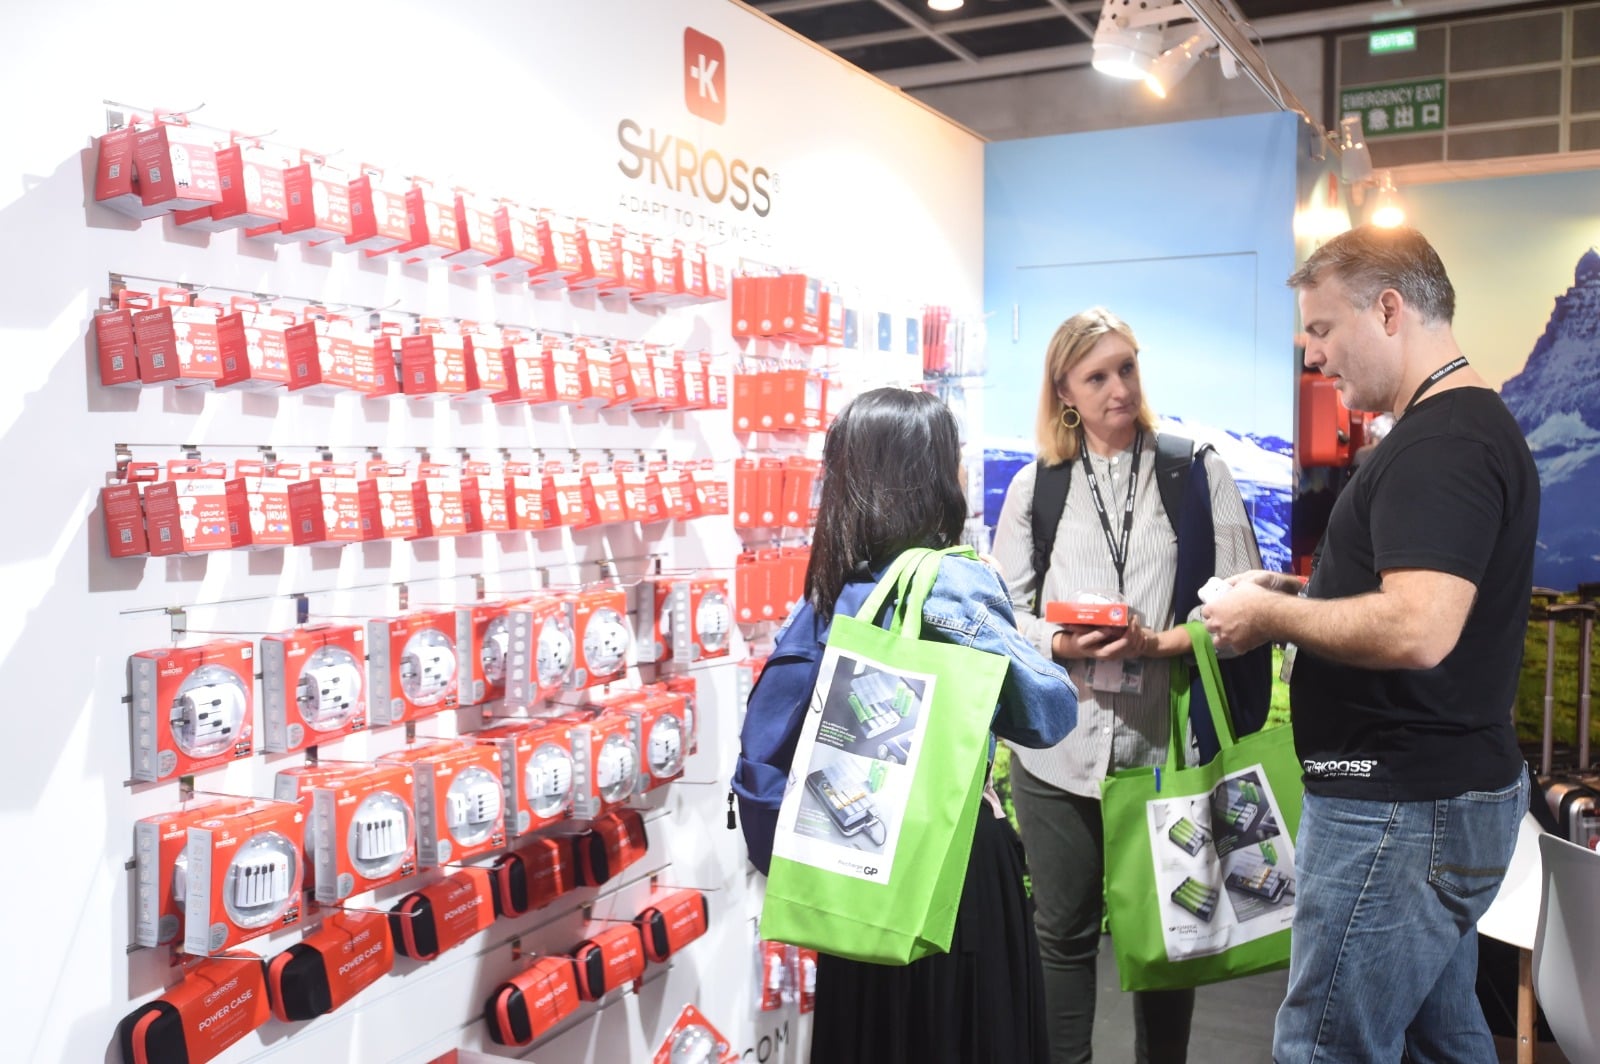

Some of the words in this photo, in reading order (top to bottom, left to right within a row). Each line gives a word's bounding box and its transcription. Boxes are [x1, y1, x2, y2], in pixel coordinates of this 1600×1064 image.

[1342, 88, 1413, 110] EMERGENCY
[1415, 83, 1442, 102] EXIT
[617, 118, 771, 218] SKROSS
[618, 194, 669, 221] ADAPT
[674, 207, 694, 228] TO
[864, 866, 878, 876] GP
[339, 954, 364, 976] POWER
[364, 941, 383, 958] CASE
[198, 1005, 230, 1031] POWER
[230, 989, 253, 1009] CASE
